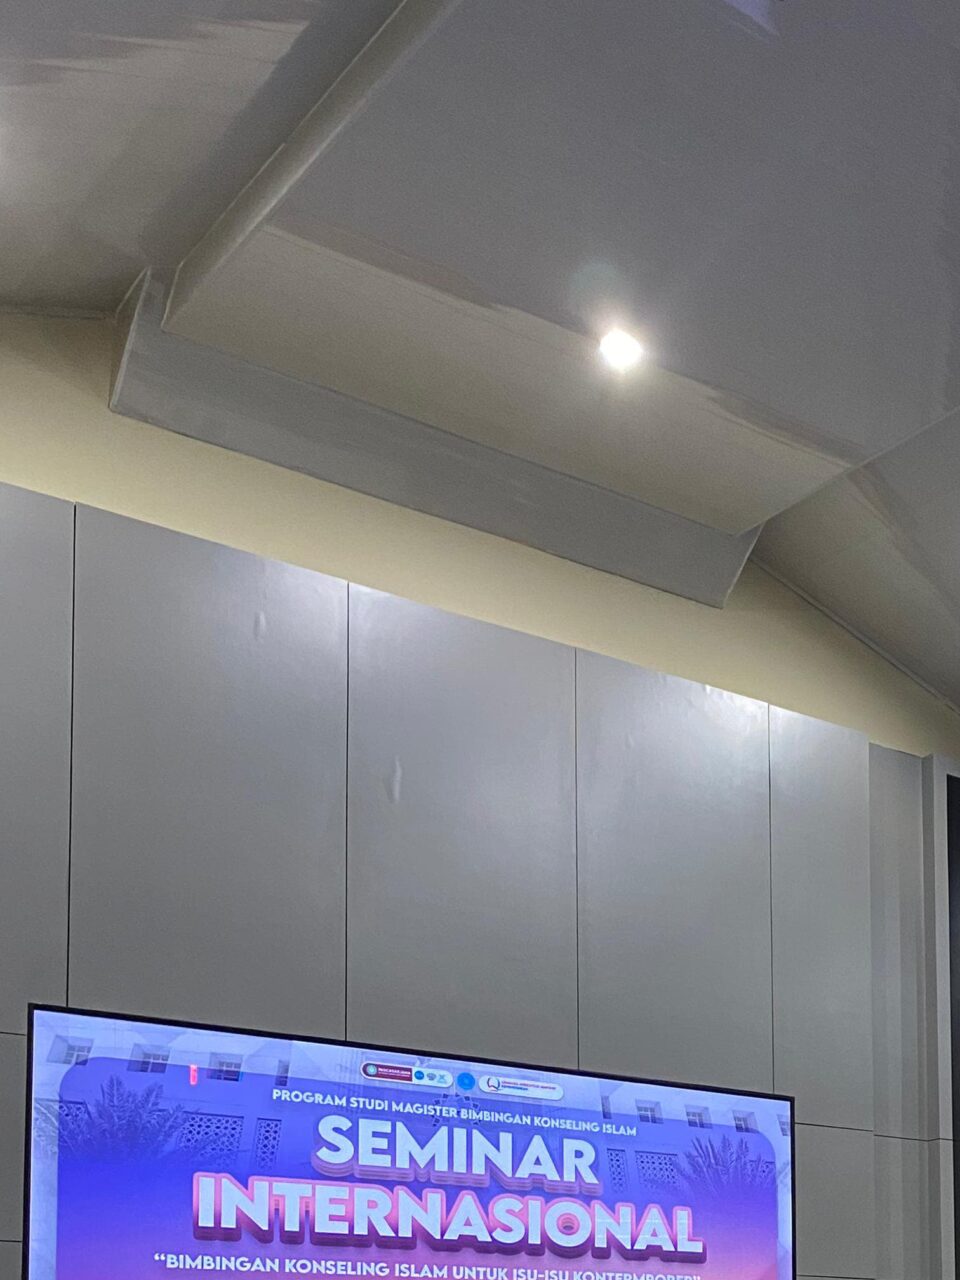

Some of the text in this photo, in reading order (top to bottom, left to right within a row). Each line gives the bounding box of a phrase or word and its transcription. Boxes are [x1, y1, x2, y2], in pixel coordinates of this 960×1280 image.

[272, 1088, 637, 1136] PROGRAM STUDI MAGISTER BIMBINGAN KONSELING ISLAM
[314, 1114, 600, 1188] SEMINAR
[196, 1174, 705, 1255] INTERNASIONAL
[154, 1253, 280, 1273] “BIMBINGAN
[284, 1258, 390, 1277] KONSELING
[394, 1263, 448, 1279] ISLAM
[452, 1266, 509, 1280] UNTUK
